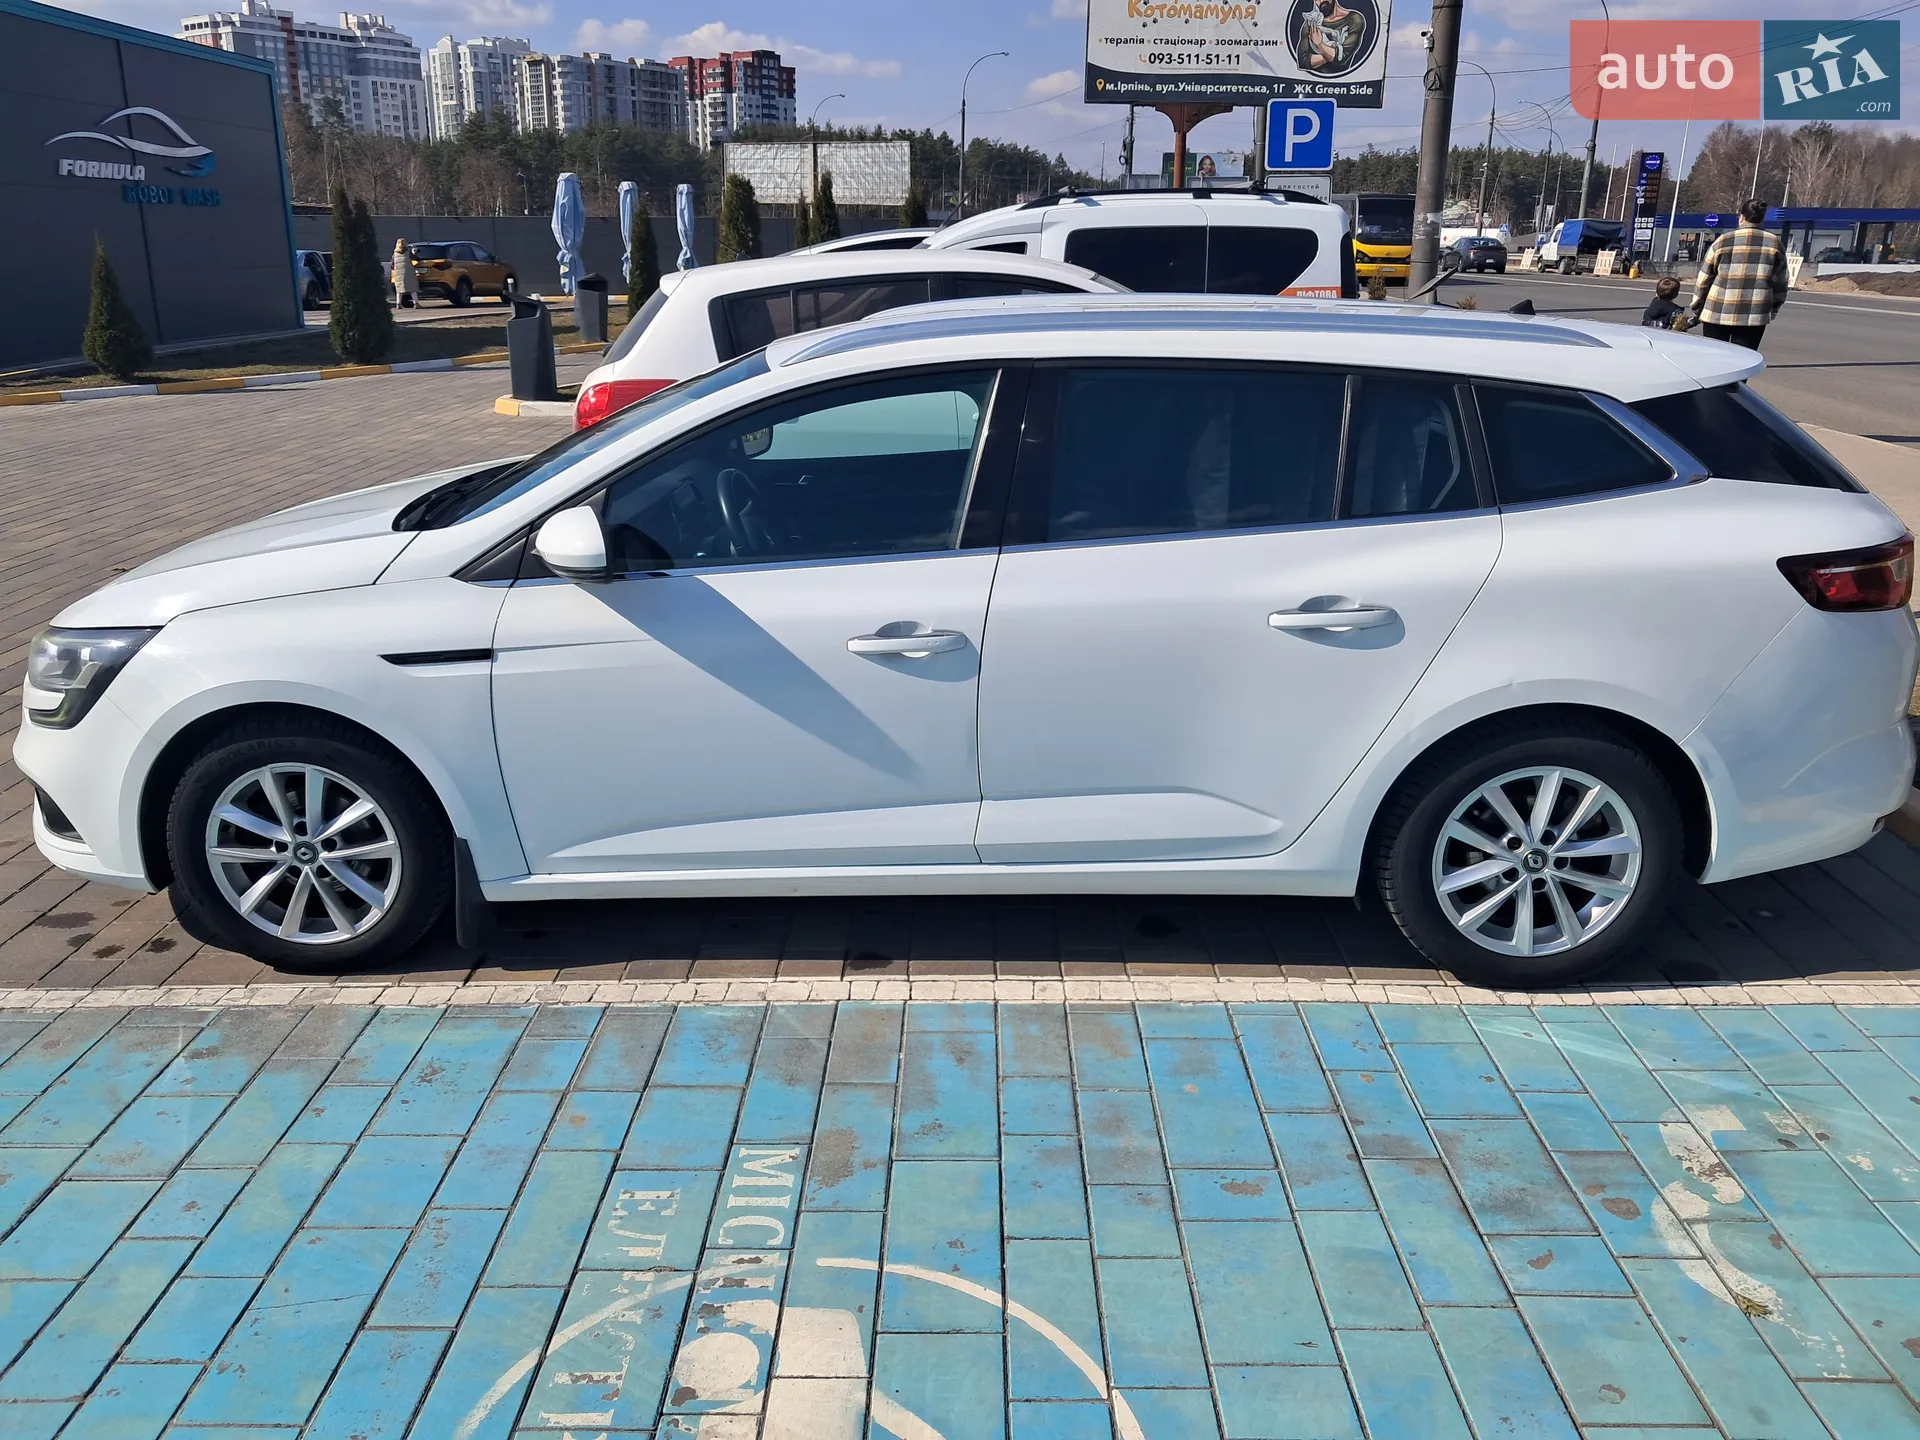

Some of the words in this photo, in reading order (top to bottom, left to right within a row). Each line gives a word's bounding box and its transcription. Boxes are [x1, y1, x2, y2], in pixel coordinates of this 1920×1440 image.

[1104, 37, 1145, 46] терапія
[1153, 37, 1206, 47] стаціонар
[1214, 38, 1278, 47] зоомагазин
[1148, 53, 1241, 65] 093-511-51-11
[1293, 84, 1312, 94] ЖК
[1315, 84, 1347, 95] Green
[1349, 85, 1373, 95] Side
[1284, 108, 1321, 162] P
[59, 158, 145, 181] FORMULA
[122, 184, 173, 205] ROBO
[218, 739, 281, 765] POLARIS
